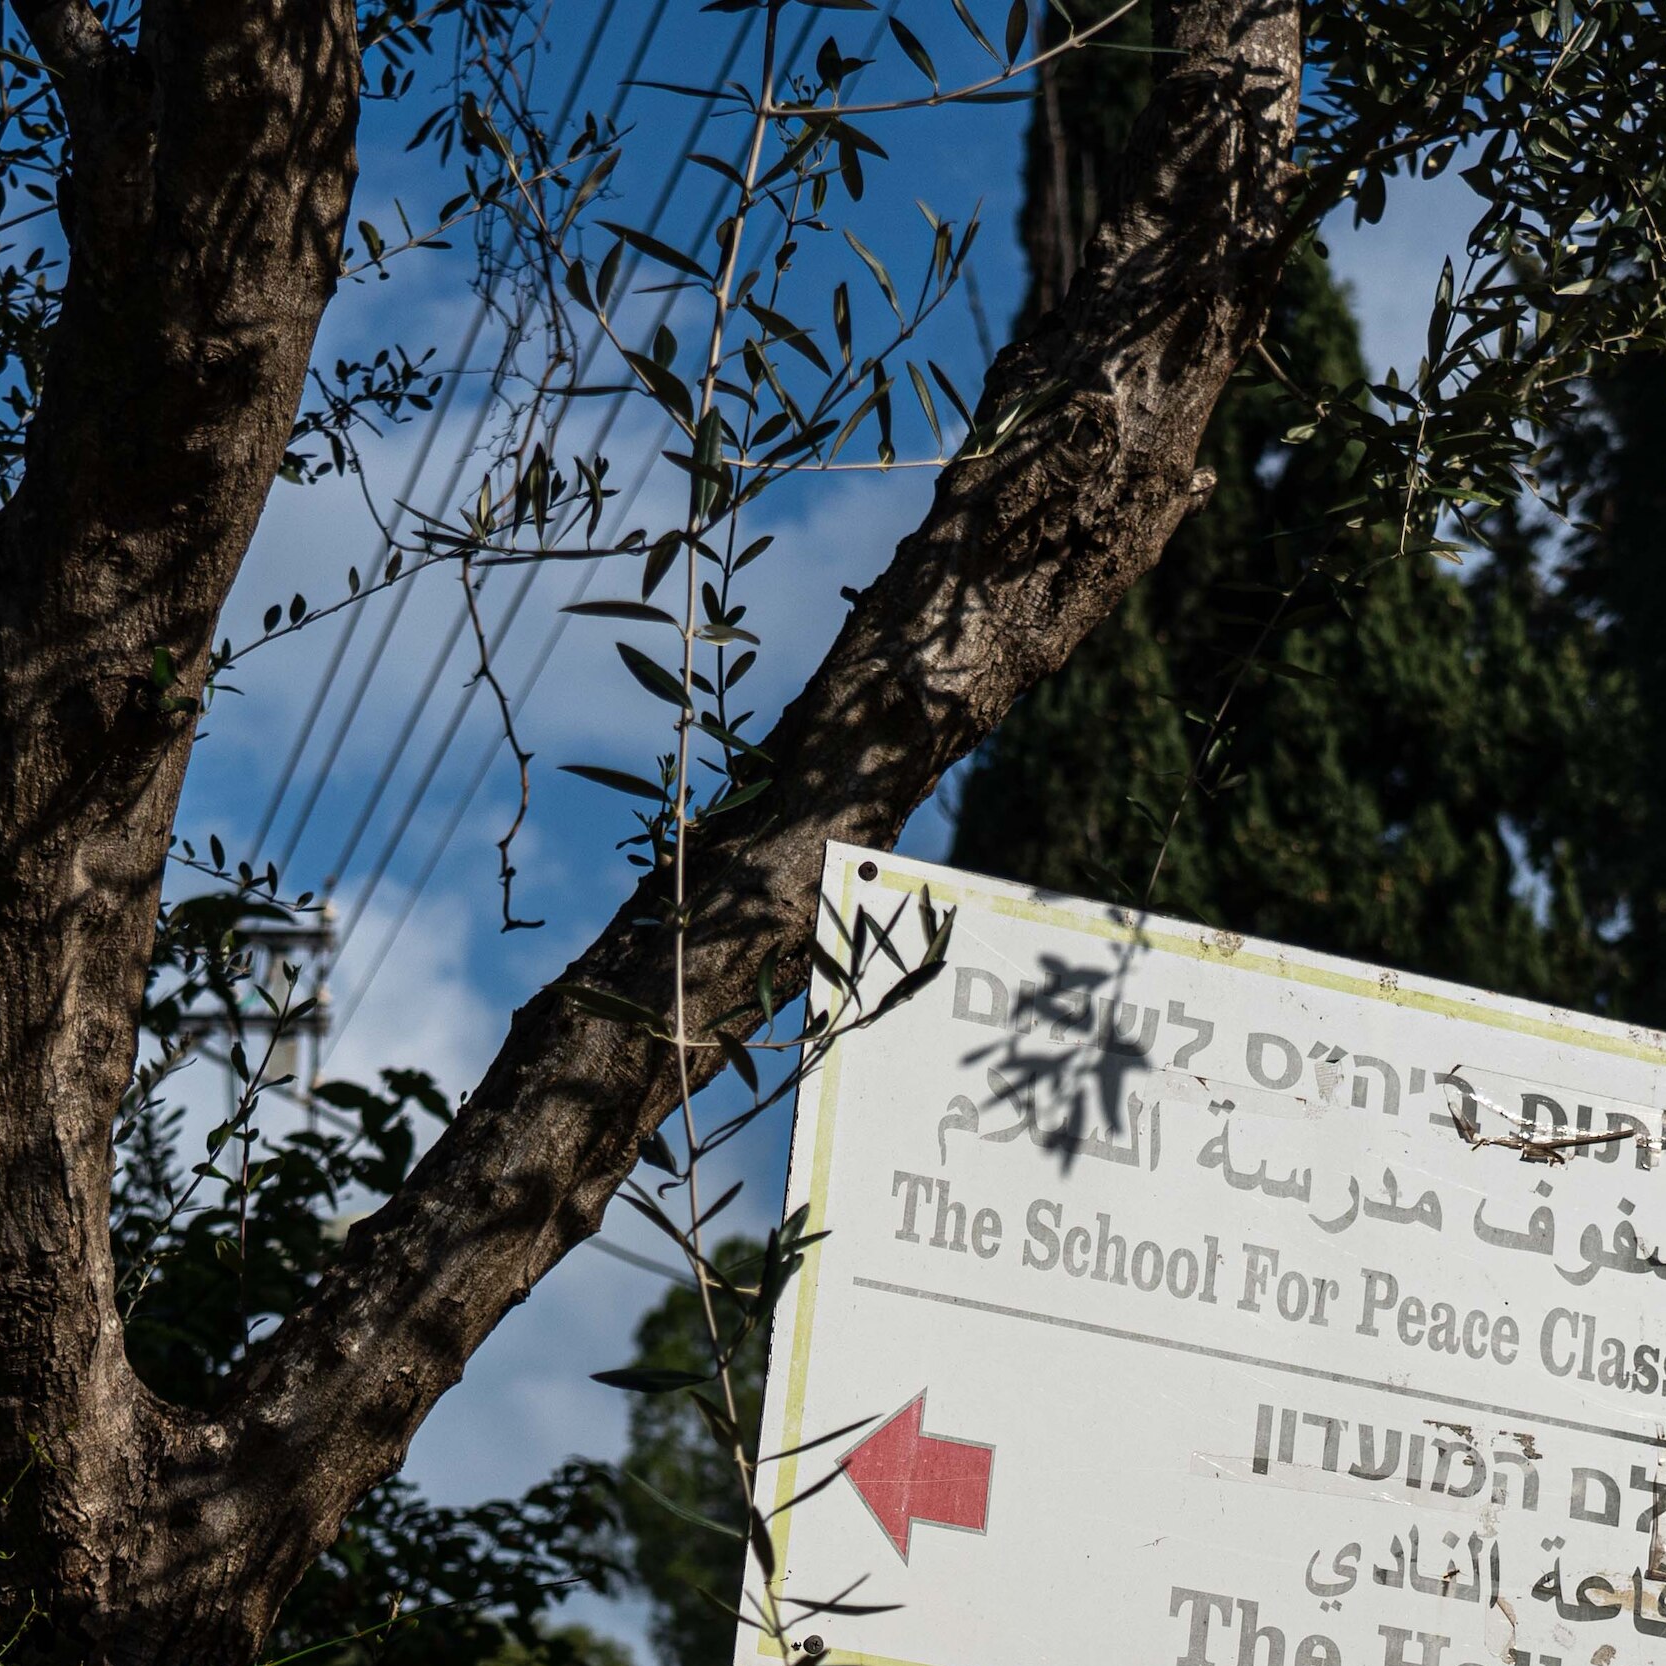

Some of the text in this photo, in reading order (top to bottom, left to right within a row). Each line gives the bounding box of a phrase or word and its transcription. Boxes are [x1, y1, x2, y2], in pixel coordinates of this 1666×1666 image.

[951, 965, 1215, 1070] לשלום
[937, 1067, 1161, 1172] السلام
[1196, 1098, 1443, 1234] مدرسة
[890, 1169, 1003, 1260] The
[1021, 1198, 1220, 1305] School
[1236, 1242, 1339, 1327] For
[1355, 1267, 1520, 1366] Peace
[1252, 1403, 1541, 1512] המועדון
[1305, 1523, 1500, 1612] النادي
